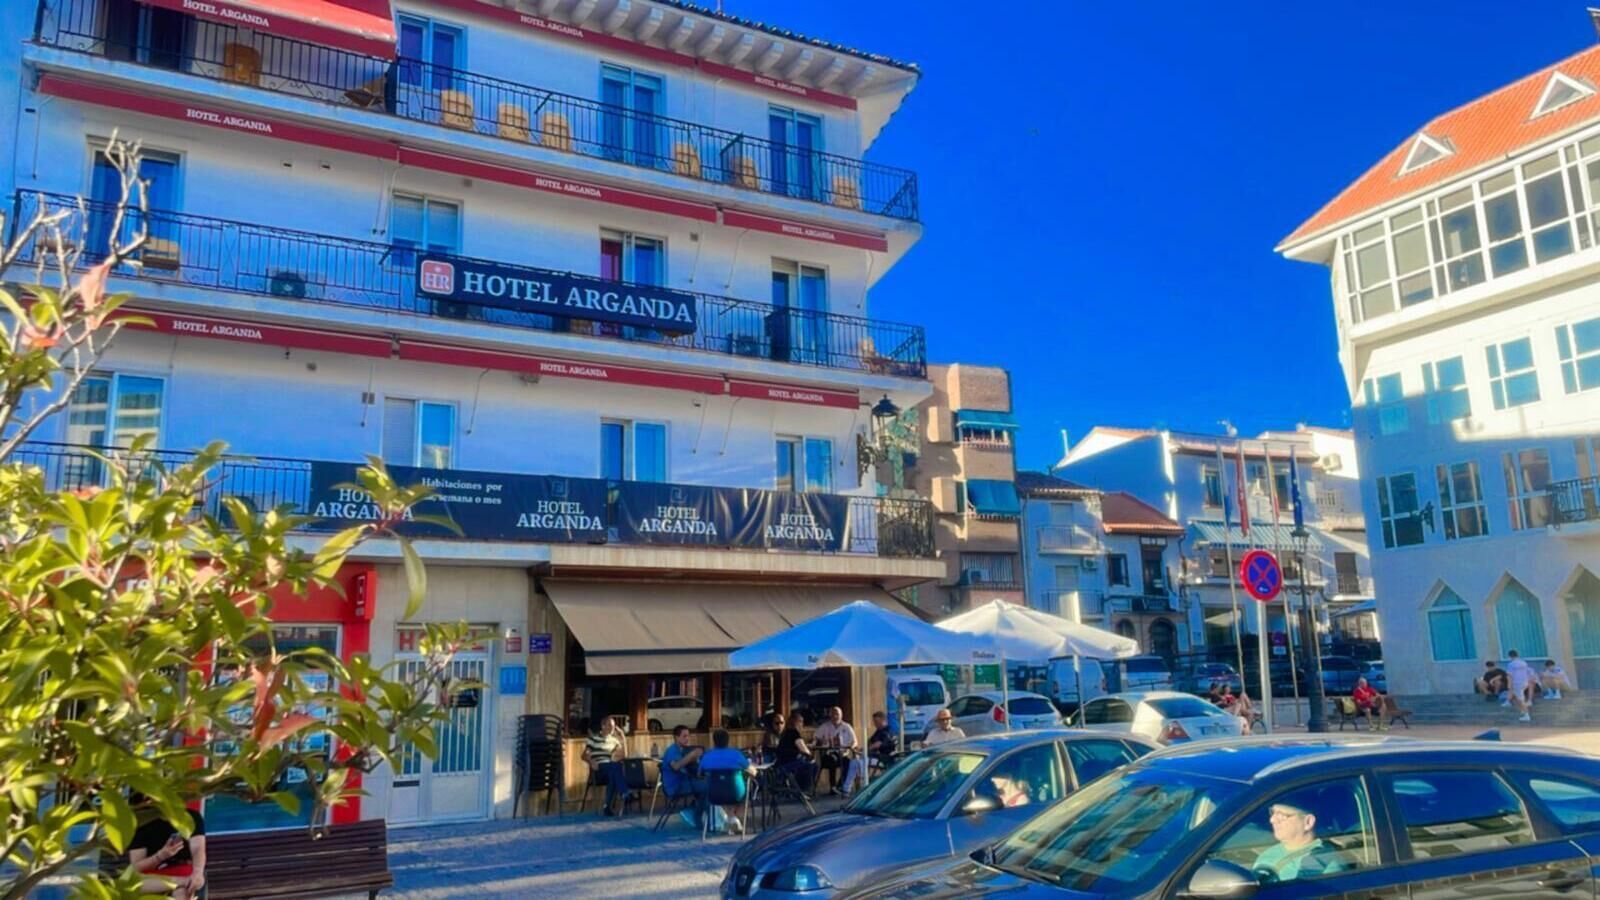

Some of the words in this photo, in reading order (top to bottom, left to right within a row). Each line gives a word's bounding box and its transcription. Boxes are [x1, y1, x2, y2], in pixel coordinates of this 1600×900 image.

[183, 0, 218, 15] HOTEL
[220, 8, 270, 27] ARGANDA
[520, 15, 546, 28] HOTEL
[547, 22, 584, 38] ARGANDA
[186, 108, 221, 123] HOTEL
[223, 116, 272, 132] ARGANDA
[535, 178, 562, 190] HOTEL
[564, 183, 601, 197] ARGANDA
[463, 271, 558, 305] HOTEL
[564, 286, 693, 323] ARGANDA
[173, 320, 209, 333] HOTEL
[211, 325, 262, 339] ARGANDA
[540, 362, 567, 374] HOTEL
[569, 366, 608, 378] ARGANDA
[768, 389, 791, 399] HOTEL
[792, 392, 824, 402] ARGANDA
[422, 477, 482, 490] Habitaciones
[486, 483, 503, 493] por
[537, 500, 584, 514] HOTEL
[657, 506, 700, 520] HOTEL
[516, 513, 603, 530] ARGANDA
[640, 518, 717, 536] ARGANDA
[780, 513, 819, 527] HOTEL
[765, 525, 834, 541] ARGANDA
